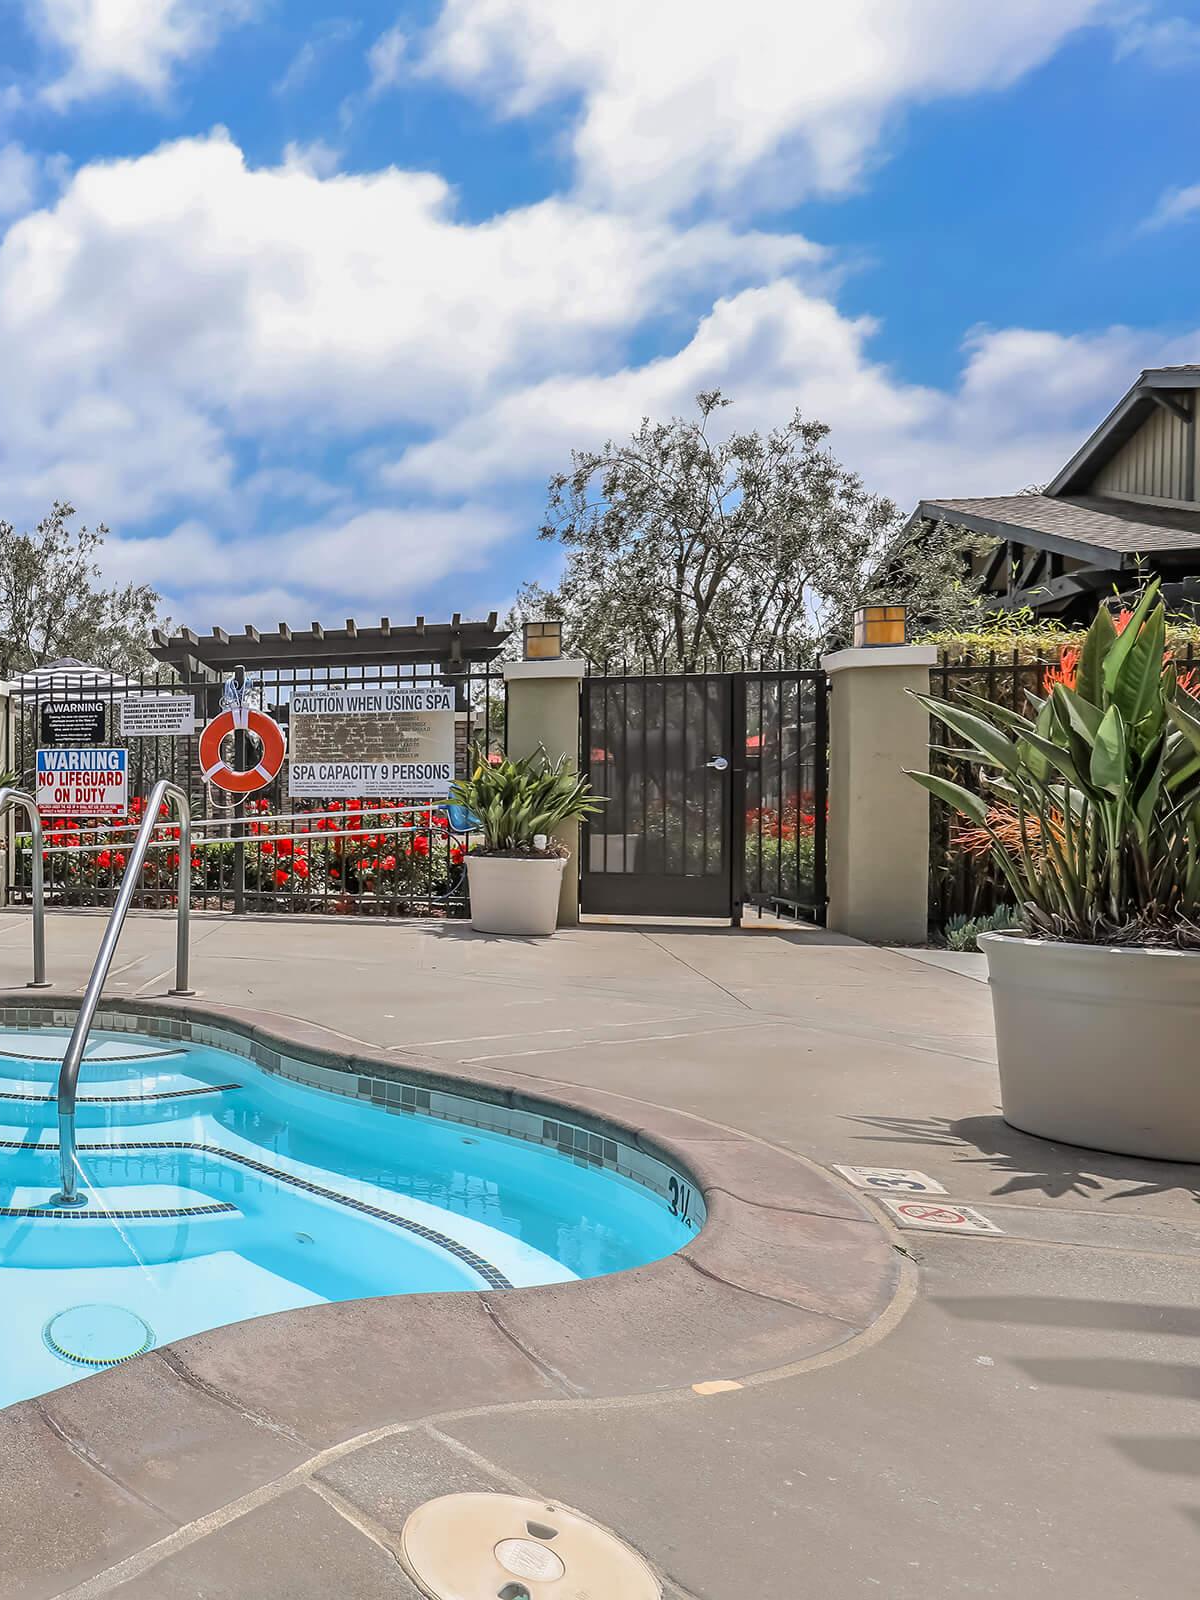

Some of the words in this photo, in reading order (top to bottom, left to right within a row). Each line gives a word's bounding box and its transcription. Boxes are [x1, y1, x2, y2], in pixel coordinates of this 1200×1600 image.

[53, 703, 104, 713] WARNING
[294, 697, 344, 713] CAUTION
[347, 695, 382, 712] WHEN
[386, 695, 422, 711] USING
[426, 694, 450, 710] SPA
[44, 751, 120, 770] WARNING
[39, 772, 54, 787] NO
[59, 771, 123, 786] LIFEGUARD
[293, 765, 316, 780] SPA
[319, 765, 378, 780] CAPACITY
[381, 765, 389, 780] 9
[392, 764, 450, 780] PERSONS
[54, 788, 70, 803] ON
[75, 788, 106, 803] DUTY
